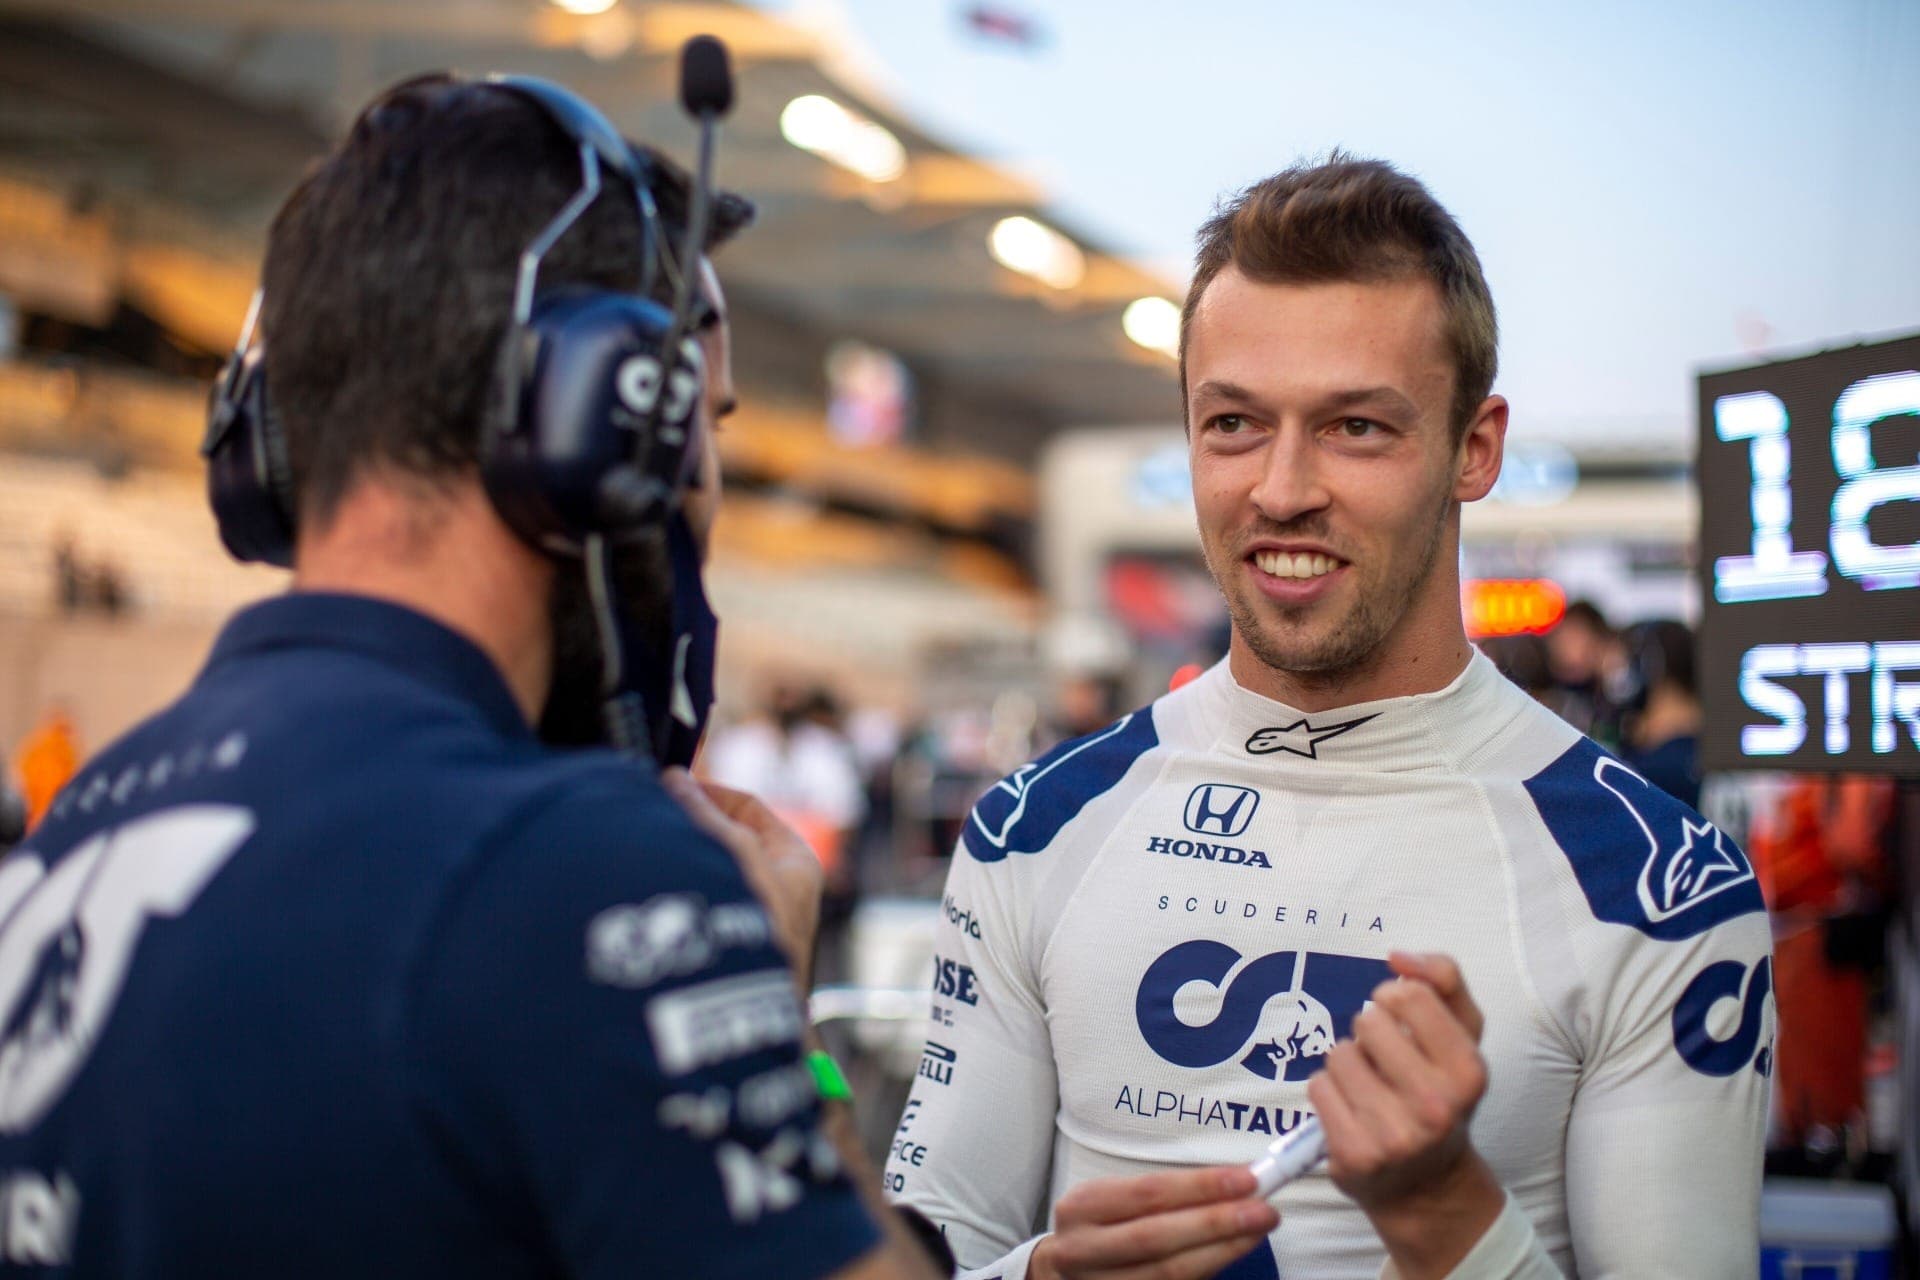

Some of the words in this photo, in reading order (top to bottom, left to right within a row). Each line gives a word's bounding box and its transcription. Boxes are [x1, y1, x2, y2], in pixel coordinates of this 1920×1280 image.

[1146, 836, 1273, 869] HONDA
[1158, 895, 1384, 932] SCUDERIA
[1114, 1084, 1317, 1137] ALPHATAU
